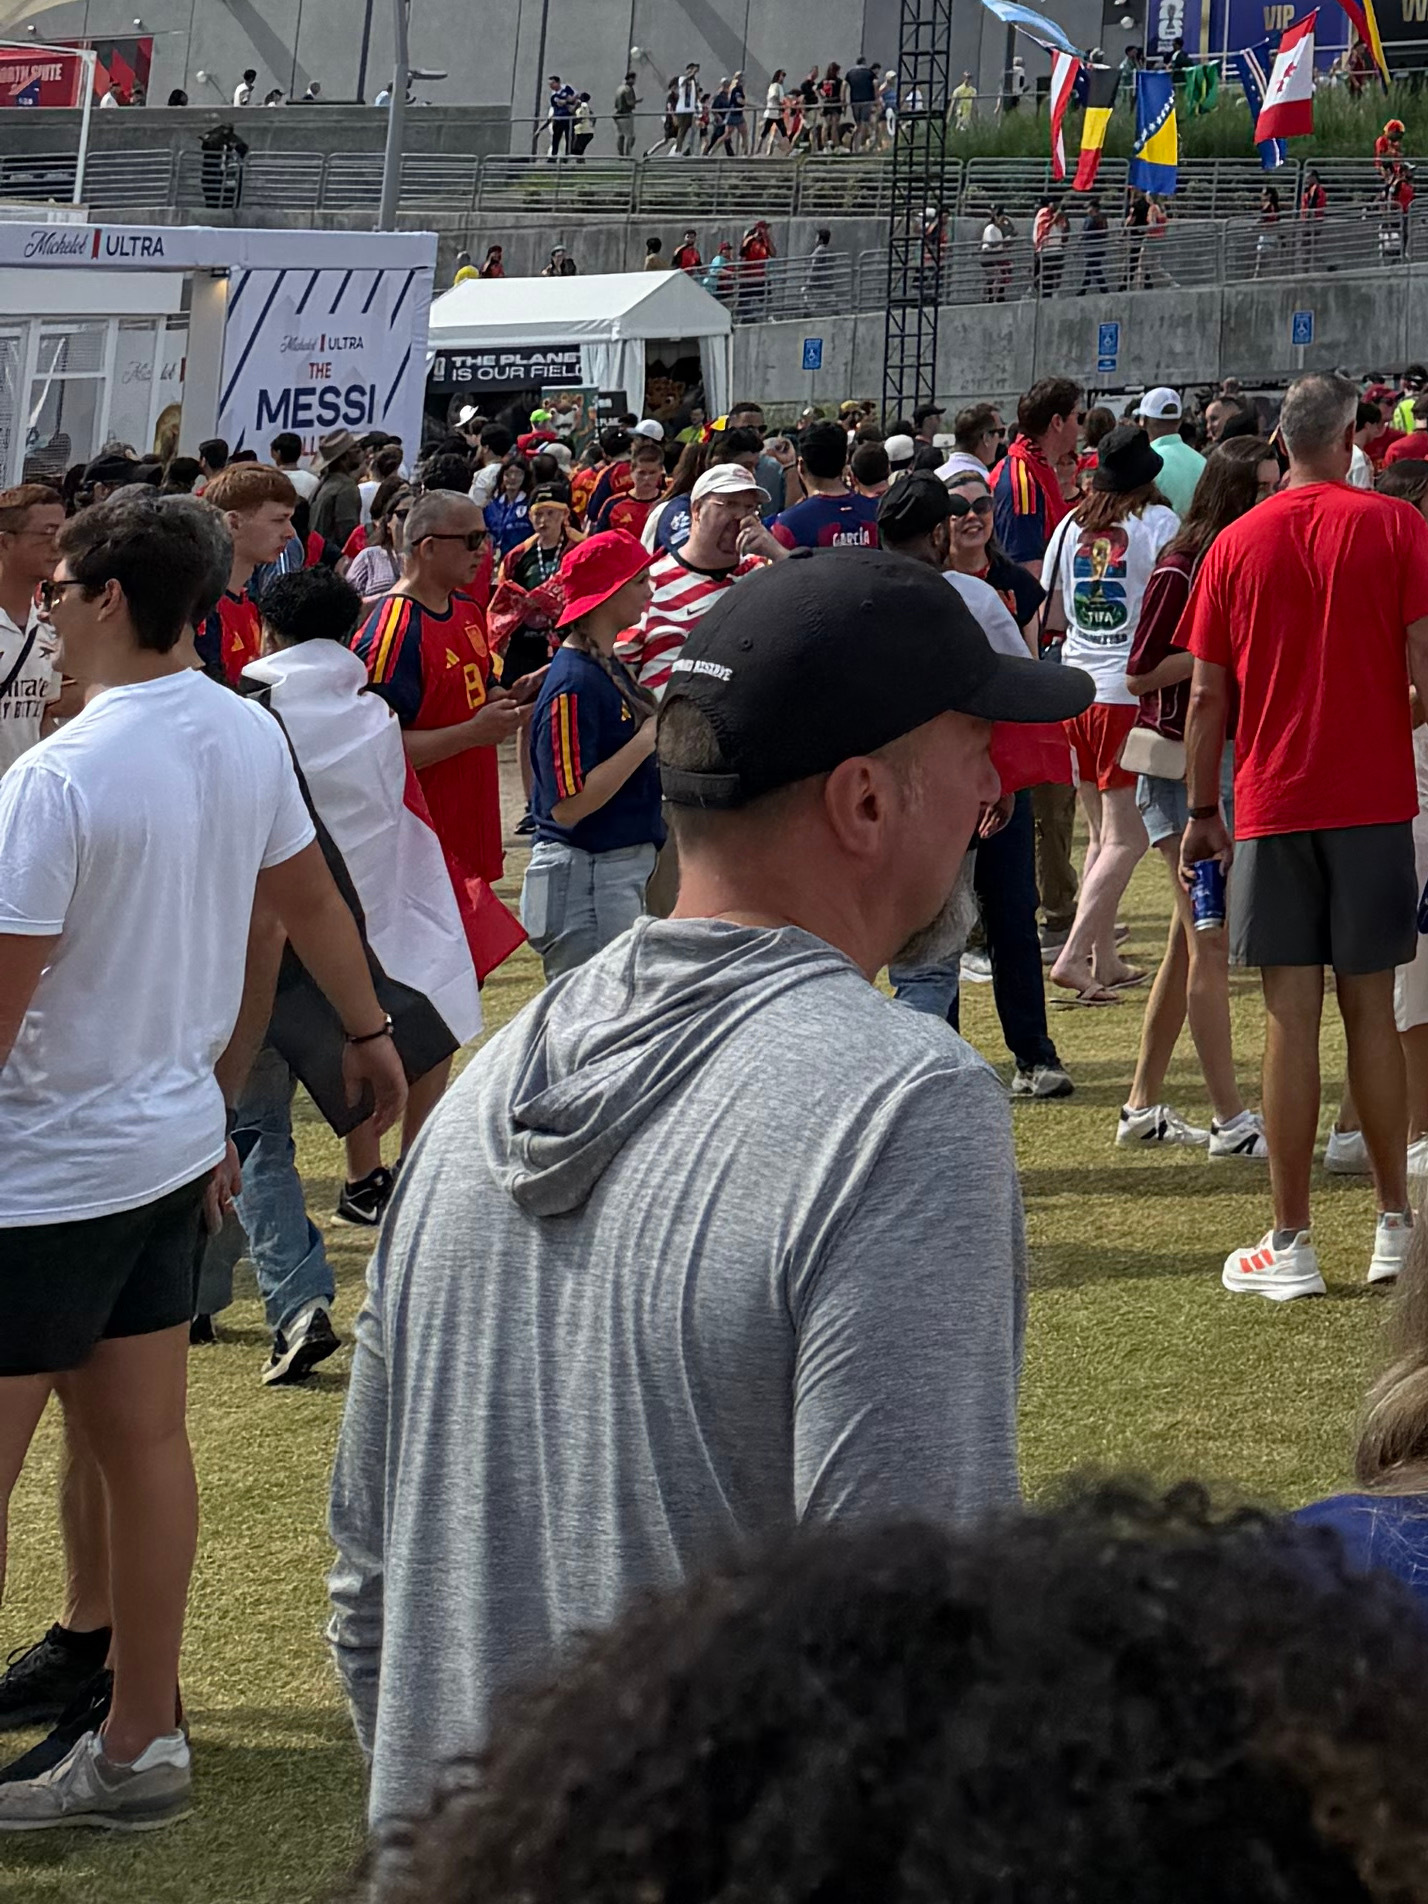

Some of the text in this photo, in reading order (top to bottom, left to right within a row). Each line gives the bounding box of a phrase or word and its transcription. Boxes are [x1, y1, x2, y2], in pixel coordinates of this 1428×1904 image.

[1263, 4, 1295, 32] VIP
[106, 236, 164, 257] ULTRA
[328, 336, 364, 351] ULTRA
[451, 351, 580, 368] THE PLANE
[308, 362, 332, 379] THE
[452, 367, 472, 382] IS
[477, 366, 525, 380] OUR
[255, 383, 376, 431] MESSI
